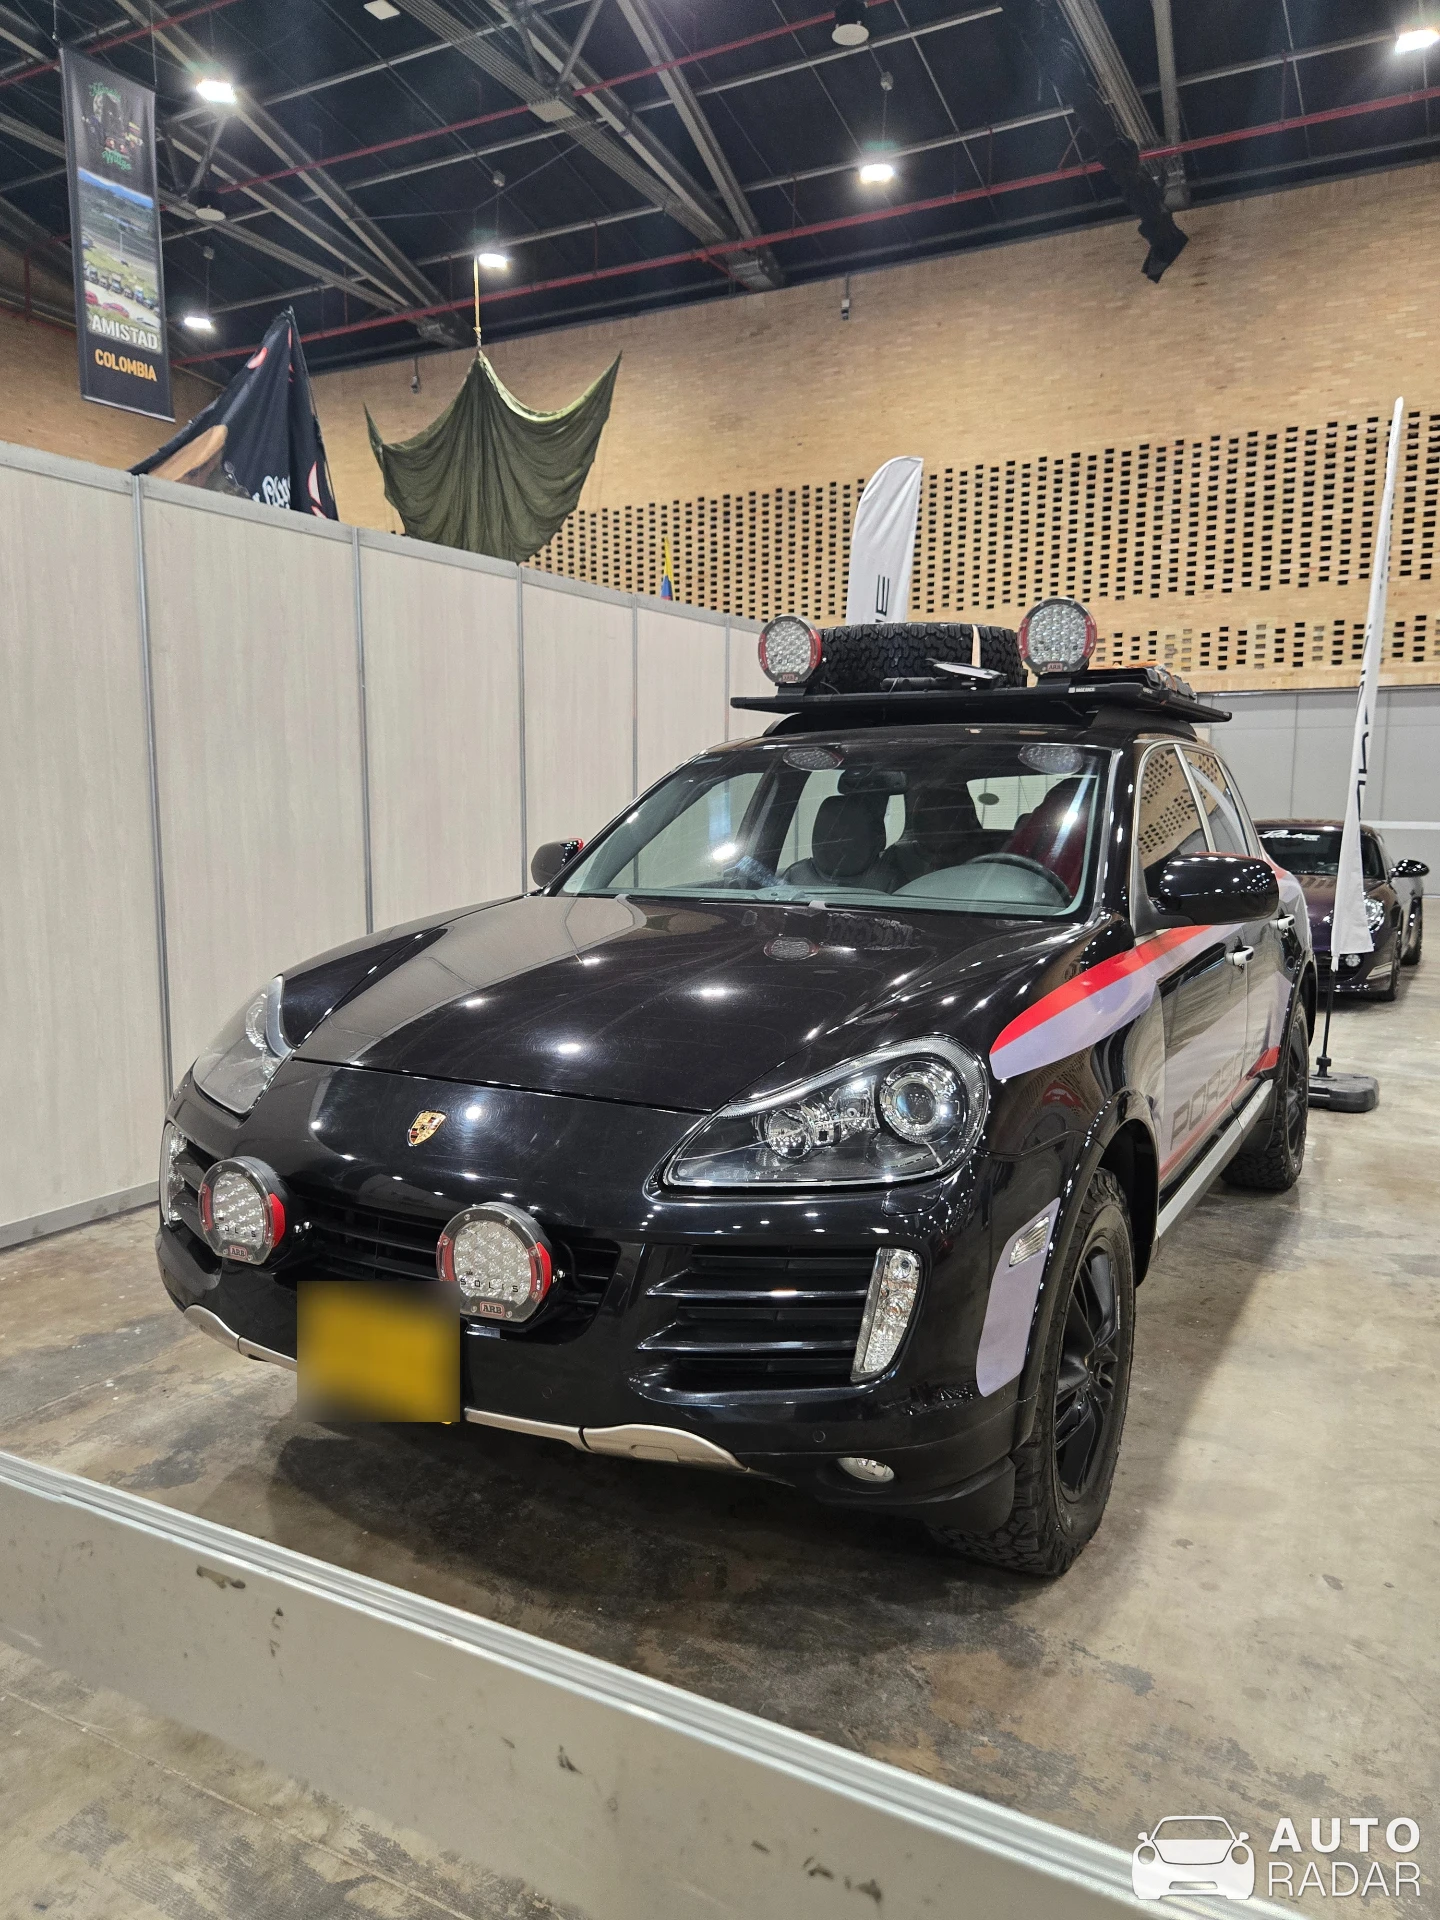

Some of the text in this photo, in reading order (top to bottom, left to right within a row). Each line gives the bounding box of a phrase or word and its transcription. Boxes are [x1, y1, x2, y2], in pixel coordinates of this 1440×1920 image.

[92, 314, 158, 350] AMISTAD
[95, 348, 157, 382] COLOMBIA
[214, 1222, 257, 1238] SOLS
[231, 1247, 246, 1257] ARB
[460, 1278, 519, 1293] SOLIS
[482, 1304, 502, 1314] ARB
